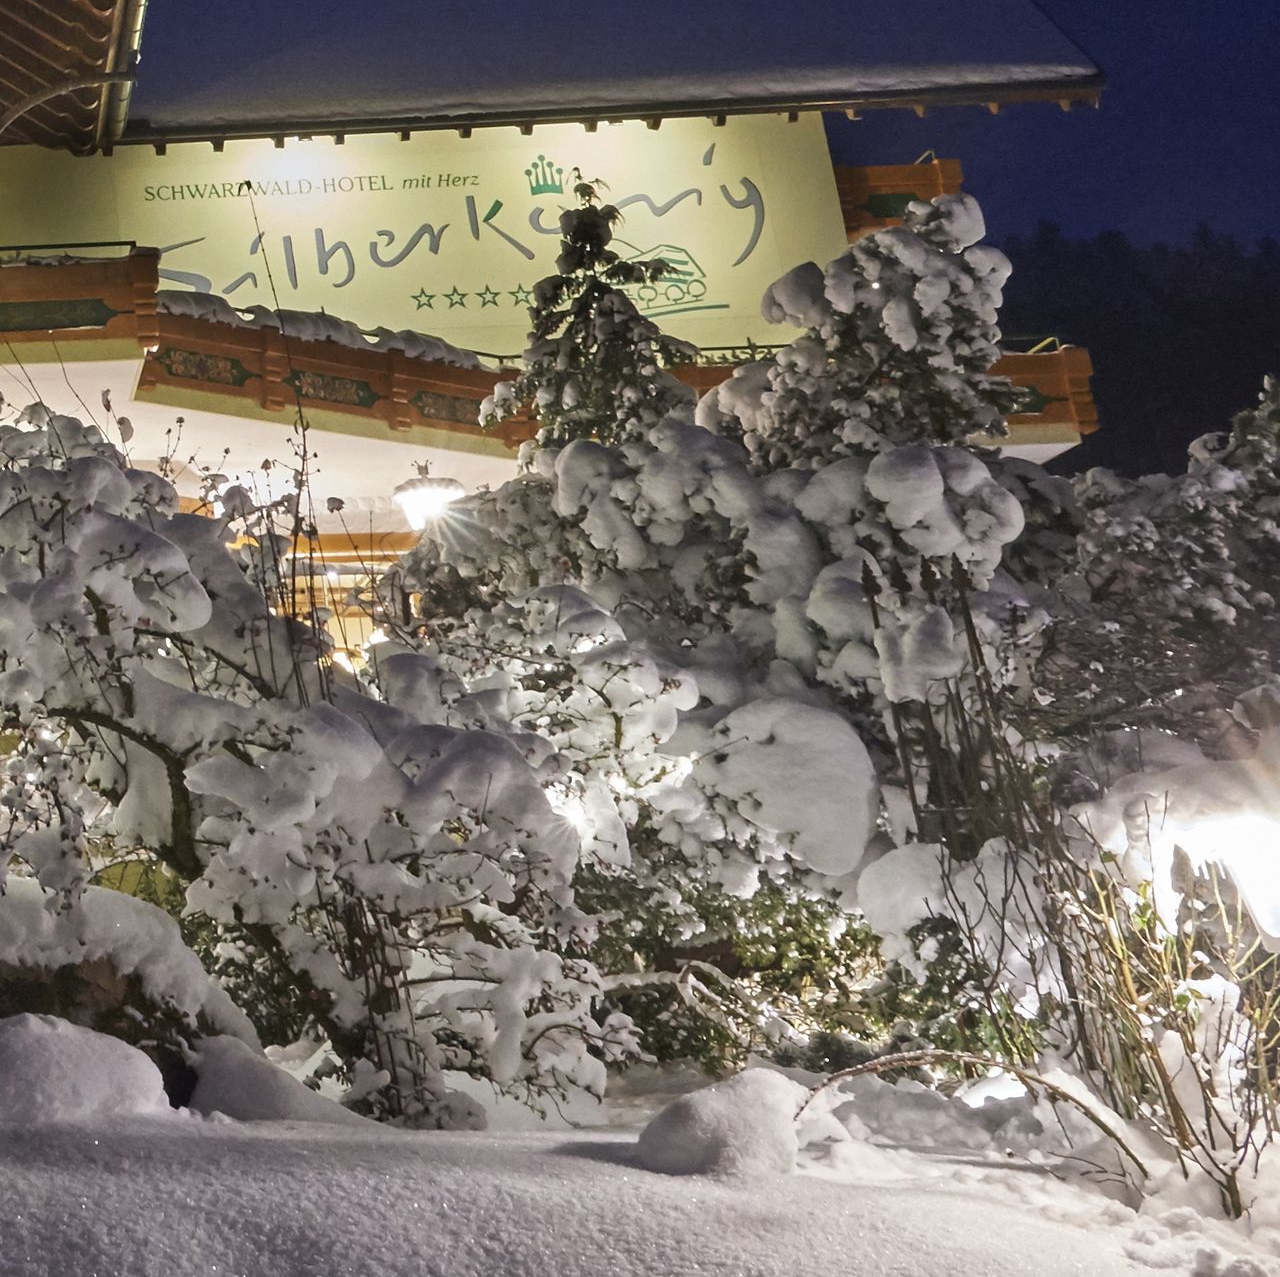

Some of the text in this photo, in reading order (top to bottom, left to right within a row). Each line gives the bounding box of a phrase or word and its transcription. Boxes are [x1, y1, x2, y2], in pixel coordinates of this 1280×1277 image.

[144, 173, 480, 202] SCHWARZWALD-HOTEL mit Herz
